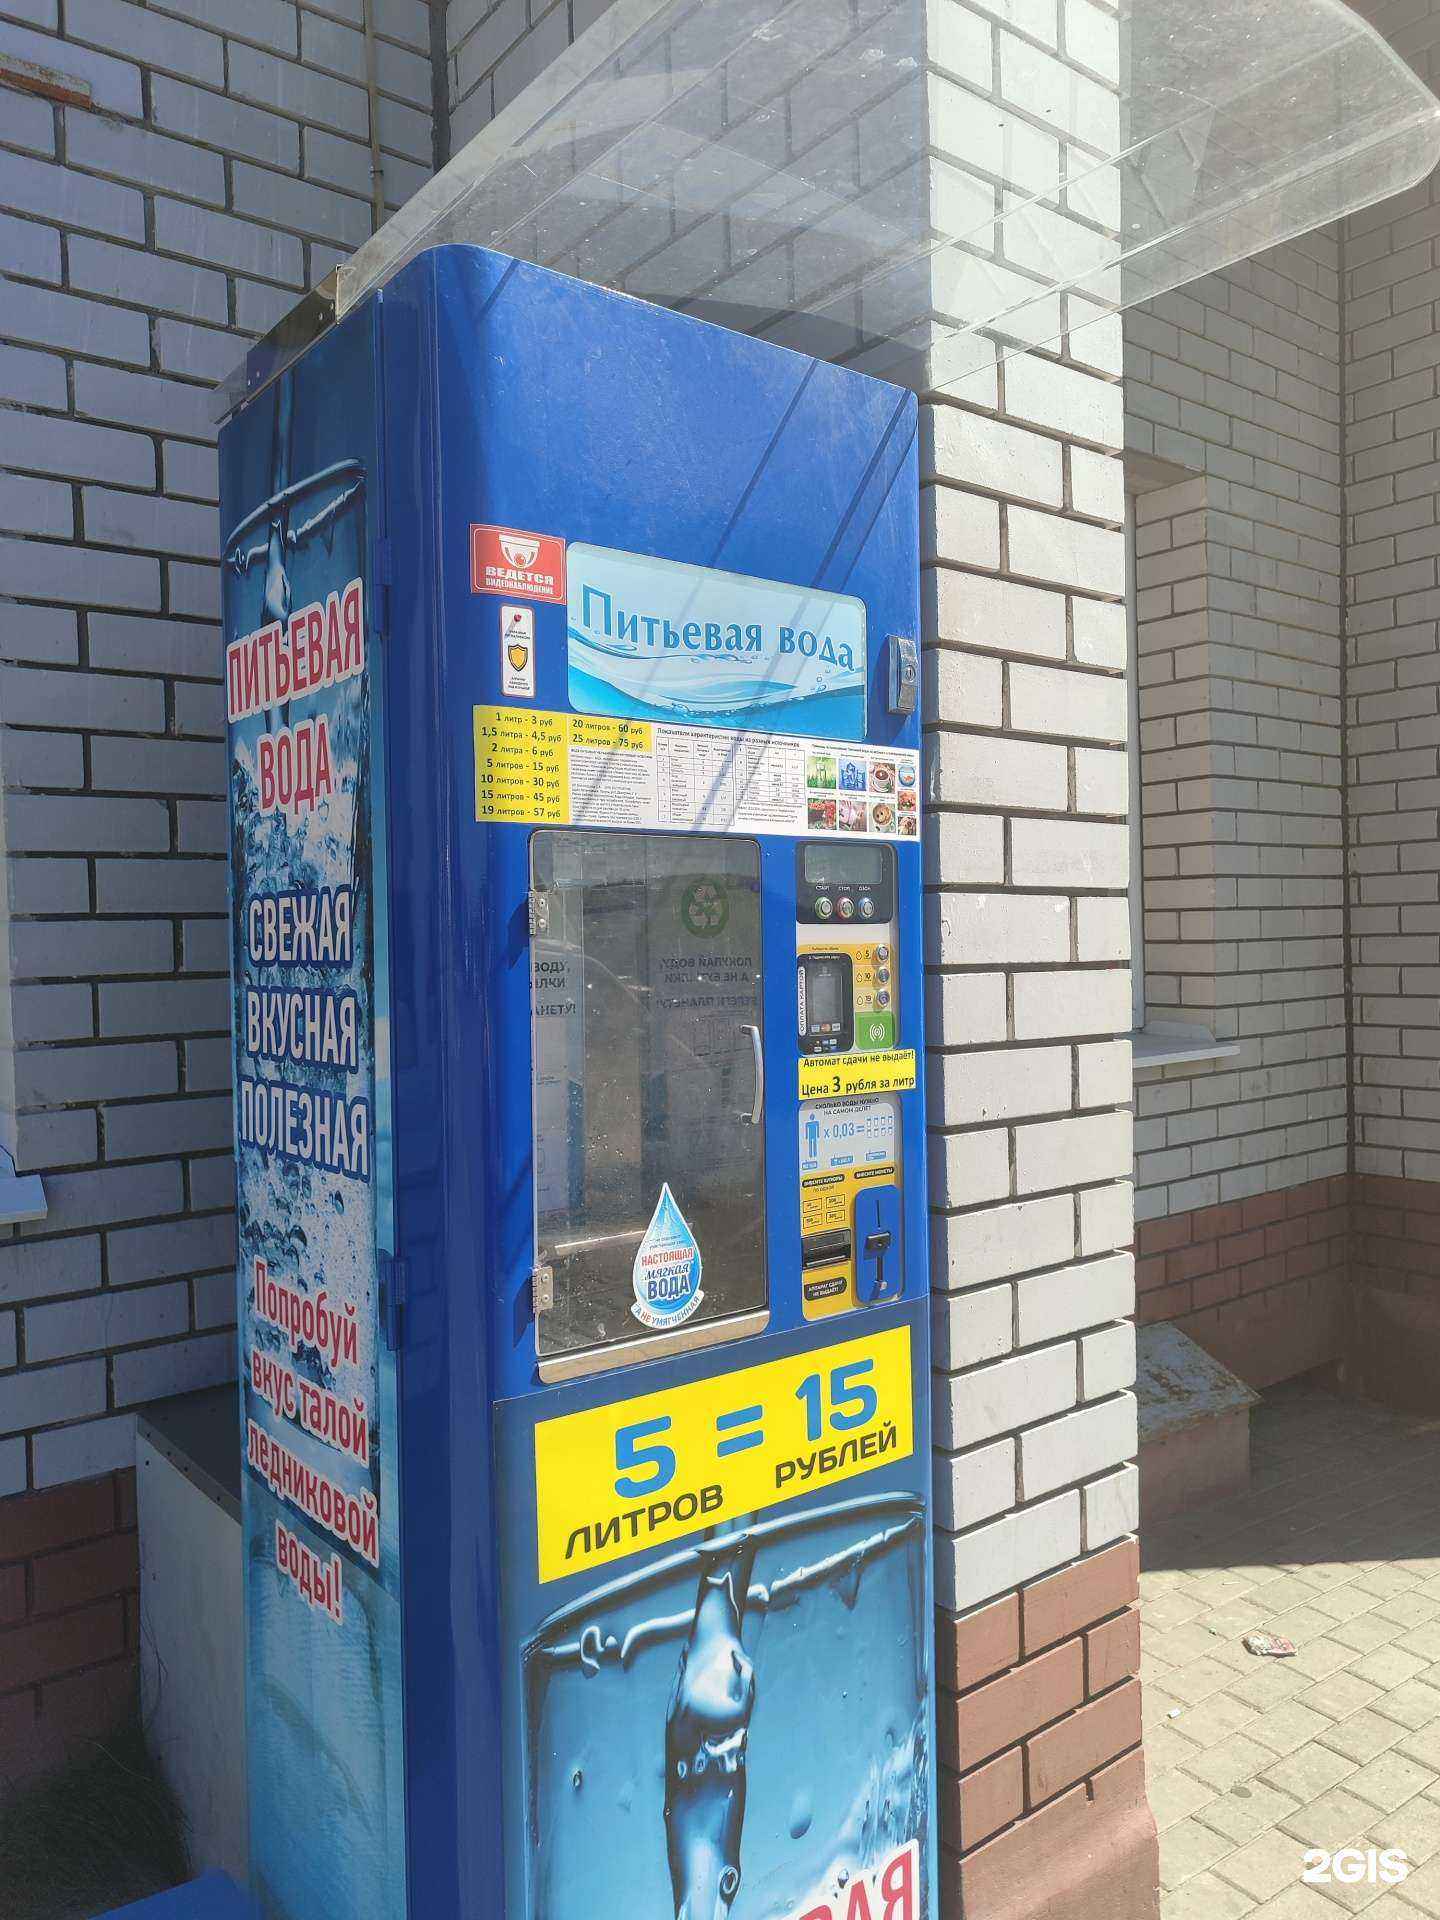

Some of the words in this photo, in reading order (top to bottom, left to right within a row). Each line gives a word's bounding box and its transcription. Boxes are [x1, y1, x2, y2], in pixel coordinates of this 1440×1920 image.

[486, 566, 554, 585] ВЕДЕТСЯ
[486, 578, 554, 594] ВИДЕОНАБЛЮДЕНИЕ
[582, 584, 762, 652] Питьевая
[779, 625, 854, 671] вода
[229, 585, 361, 715] ПИТЬЕВАЯ
[496, 712, 501, 721] 1
[531, 716, 537, 725] 3
[539, 718, 553, 727] руб
[572, 719, 584, 728] 20
[585, 723, 610, 732] литров
[618, 724, 629, 733] 60
[630, 728, 643, 736] руб
[482, 727, 497, 737] 1,5
[531, 731, 546, 742] 4,5
[548, 735, 562, 743] руб
[573, 733, 584, 743] 25
[586, 737, 611, 746] литров
[619, 738, 629, 747] 75
[631, 741, 644, 750] руб
[492, 743, 498, 752] 2
[500, 747, 523, 755] литра
[532, 746, 538, 756] 6
[261, 720, 332, 814] ВОДА
[487, 758, 493, 768] 5
[495, 762, 524, 771] литров
[532, 761, 544, 771] 15
[546, 764, 560, 773] руб
[481, 774, 493, 783] 10
[496, 778, 524, 786] литров
[533, 777, 544, 786] 30
[546, 780, 560, 789] руб
[481, 790, 494, 799] 15
[496, 793, 524, 801] литров
[533, 792, 544, 801] 45
[546, 795, 560, 804] руб
[481, 805, 494, 815] 19
[496, 808, 525, 817] литров
[533, 808, 545, 817] 57
[547, 811, 561, 819] руб
[249, 892, 350, 963] СВЕЖАЯ
[248, 991, 358, 1068] ВКУСНАЯ
[803, 1057, 840, 1068] Автомат
[842, 1055, 868, 1066] сдачи
[870, 1054, 880, 1063] не
[802, 1084, 829, 1098] Цена
[833, 1076, 841, 1093] 3
[846, 1078, 877, 1094] рубля
[879, 1079, 890, 1089] за
[893, 1077, 914, 1089] литр
[241, 1080, 369, 1176] ПОЛЕЗНАЯ
[833, 1122, 855, 1139] 0,03
[641, 1249, 693, 1266] НАСТОЯЩАЯ
[644, 1264, 689, 1280] мягкая
[648, 1275, 690, 1300] ВОДА
[255, 1262, 358, 1367] Попробуй
[641, 1311, 652, 1323] НЕ
[651, 1296, 700, 1326] УМЯГЧЕННАЯ
[252, 1350, 295, 1416] вкус
[299, 1380, 368, 1462] талой
[614, 1415, 677, 1499] 5
[795, 1358, 878, 1442] 15
[249, 1425, 376, 1561] ледниковой
[564, 1484, 724, 1560] ЛИТРОВ
[775, 1420, 897, 1489] РУБЛЕЙ
[277, 1523, 341, 1619] воды!
[799, 1849, 913, 1920] АЯ
